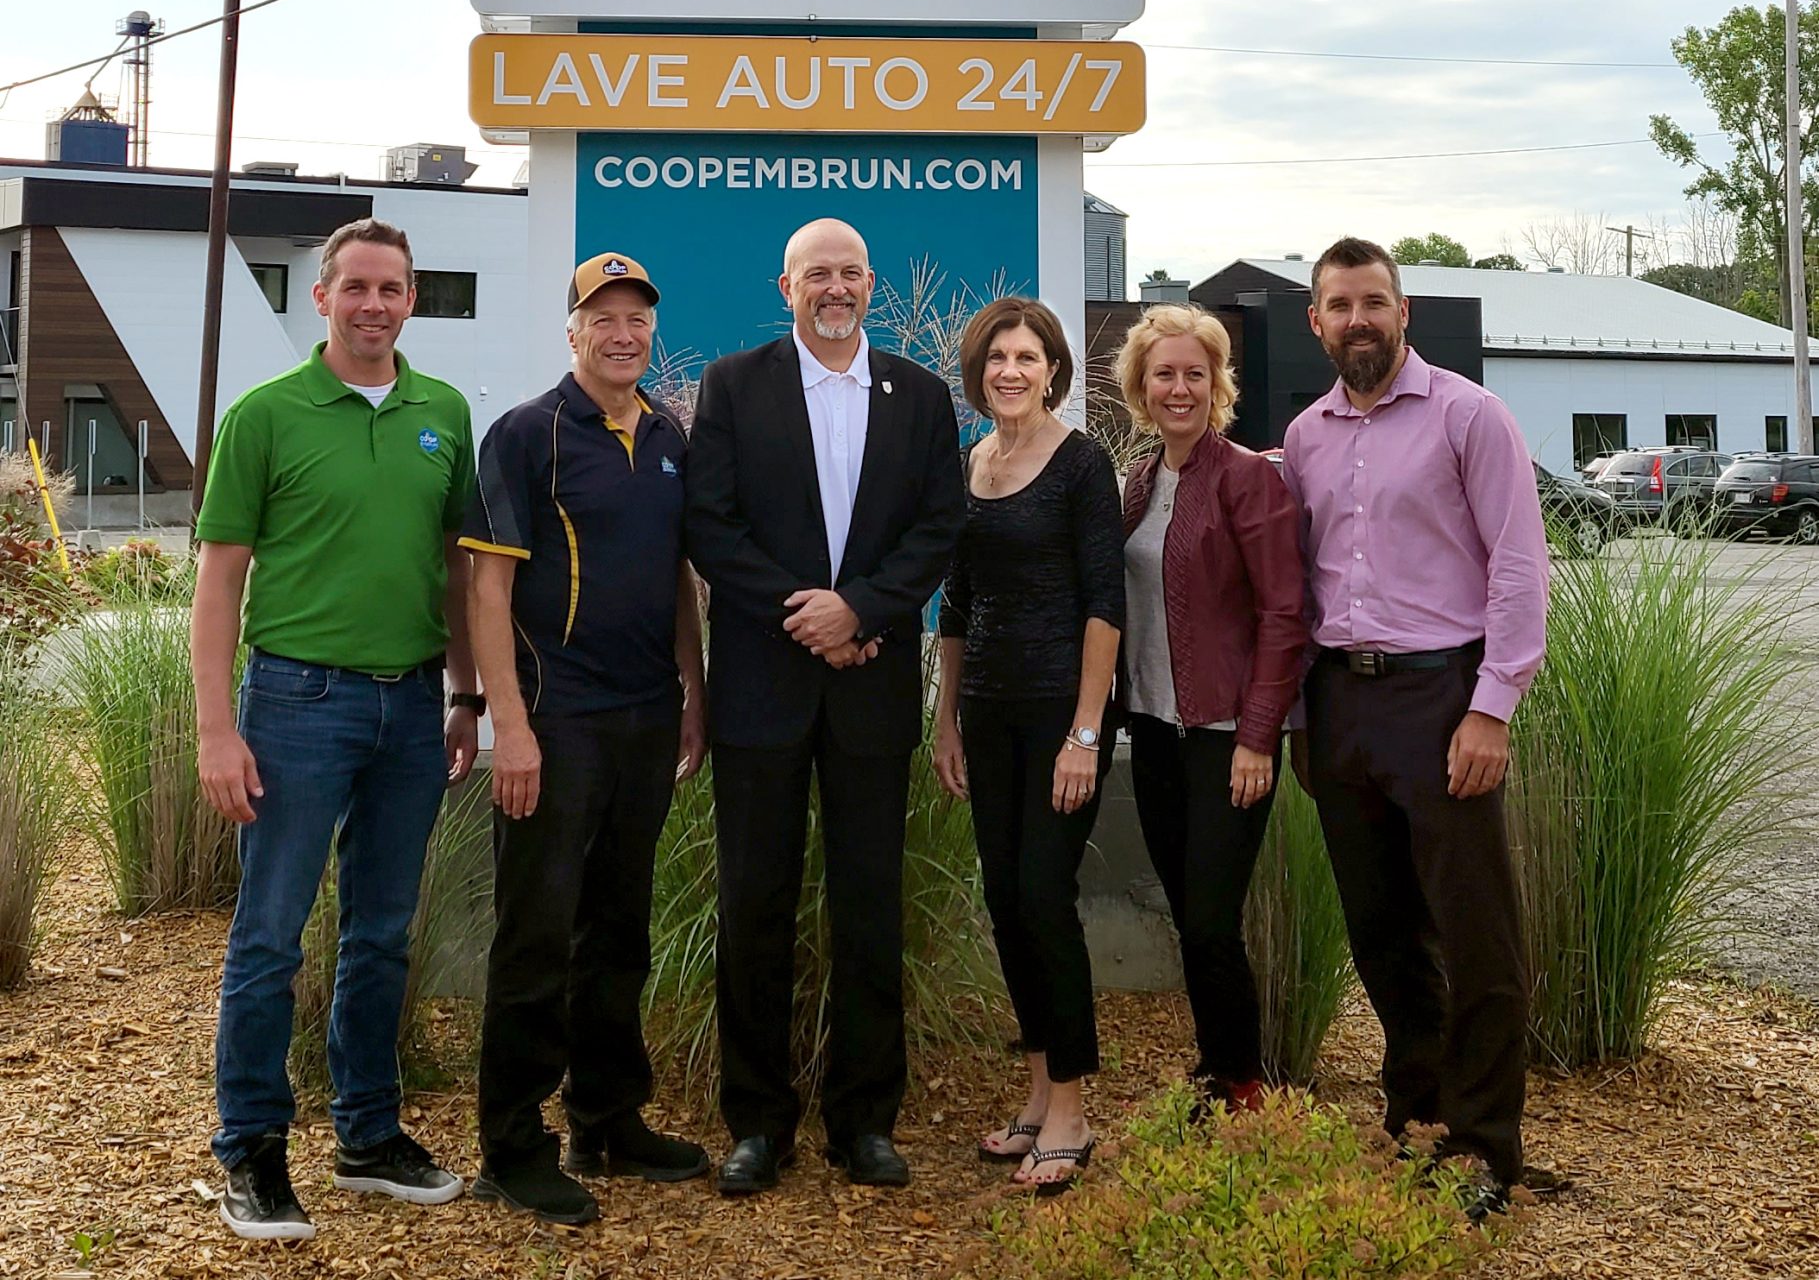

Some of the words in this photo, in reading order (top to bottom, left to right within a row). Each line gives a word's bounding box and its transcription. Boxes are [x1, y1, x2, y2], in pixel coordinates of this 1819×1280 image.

[492, 52, 689, 108] LAVE
[716, 55, 929, 111] AUTO
[956, 53, 1122, 121] 24/7
[594, 156, 1022, 191] COOPEMBRUN.COM
